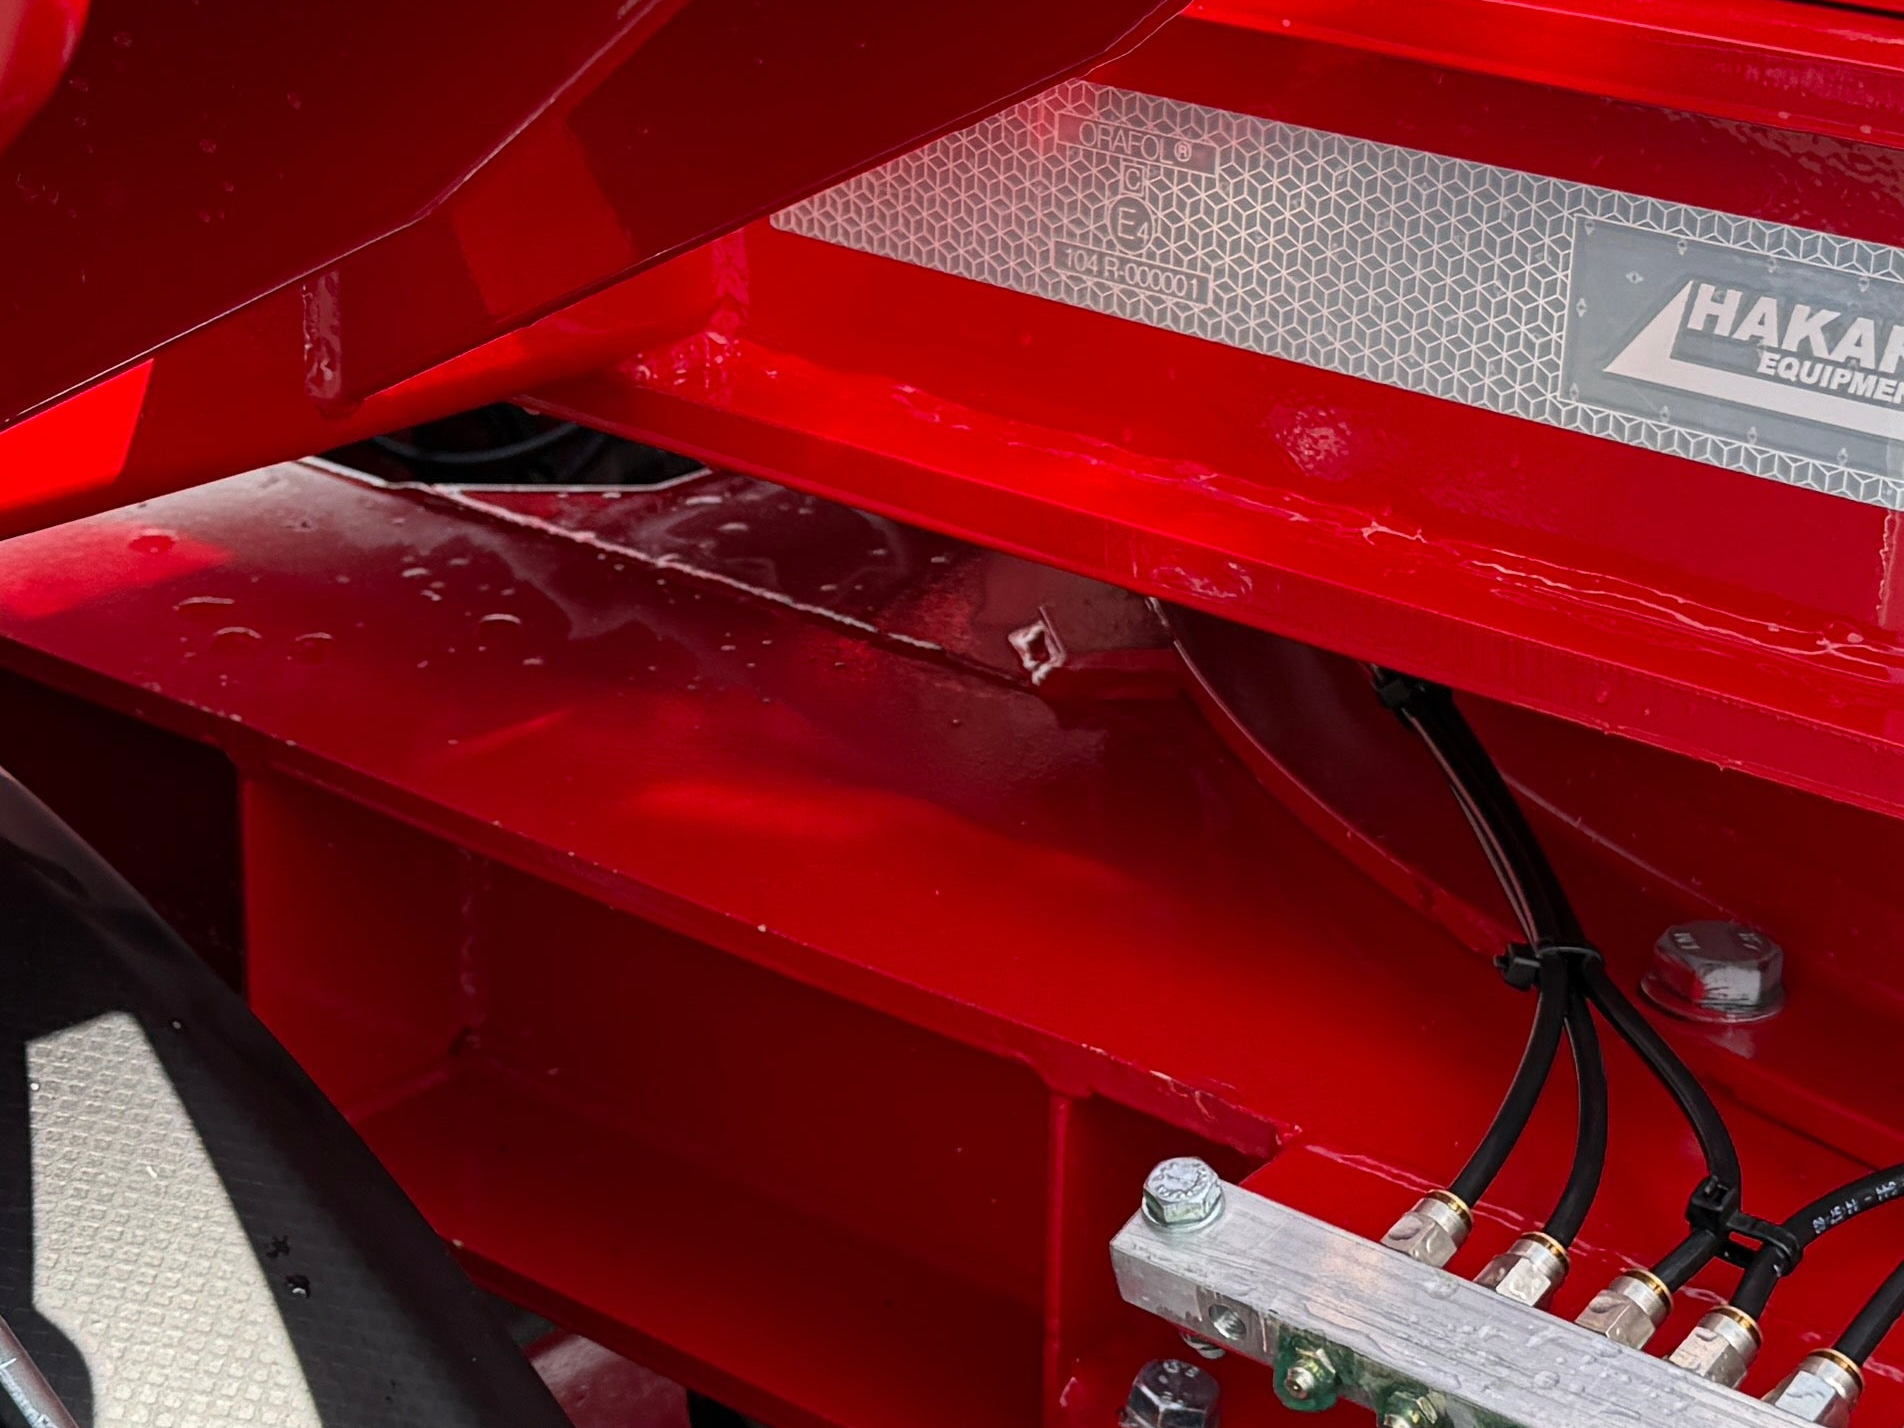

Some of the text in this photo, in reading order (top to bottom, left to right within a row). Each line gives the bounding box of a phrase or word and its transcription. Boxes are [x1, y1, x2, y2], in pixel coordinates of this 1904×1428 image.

[1125, 168, 1141, 191] C
[1065, 247, 1198, 300] 104 R-000001
